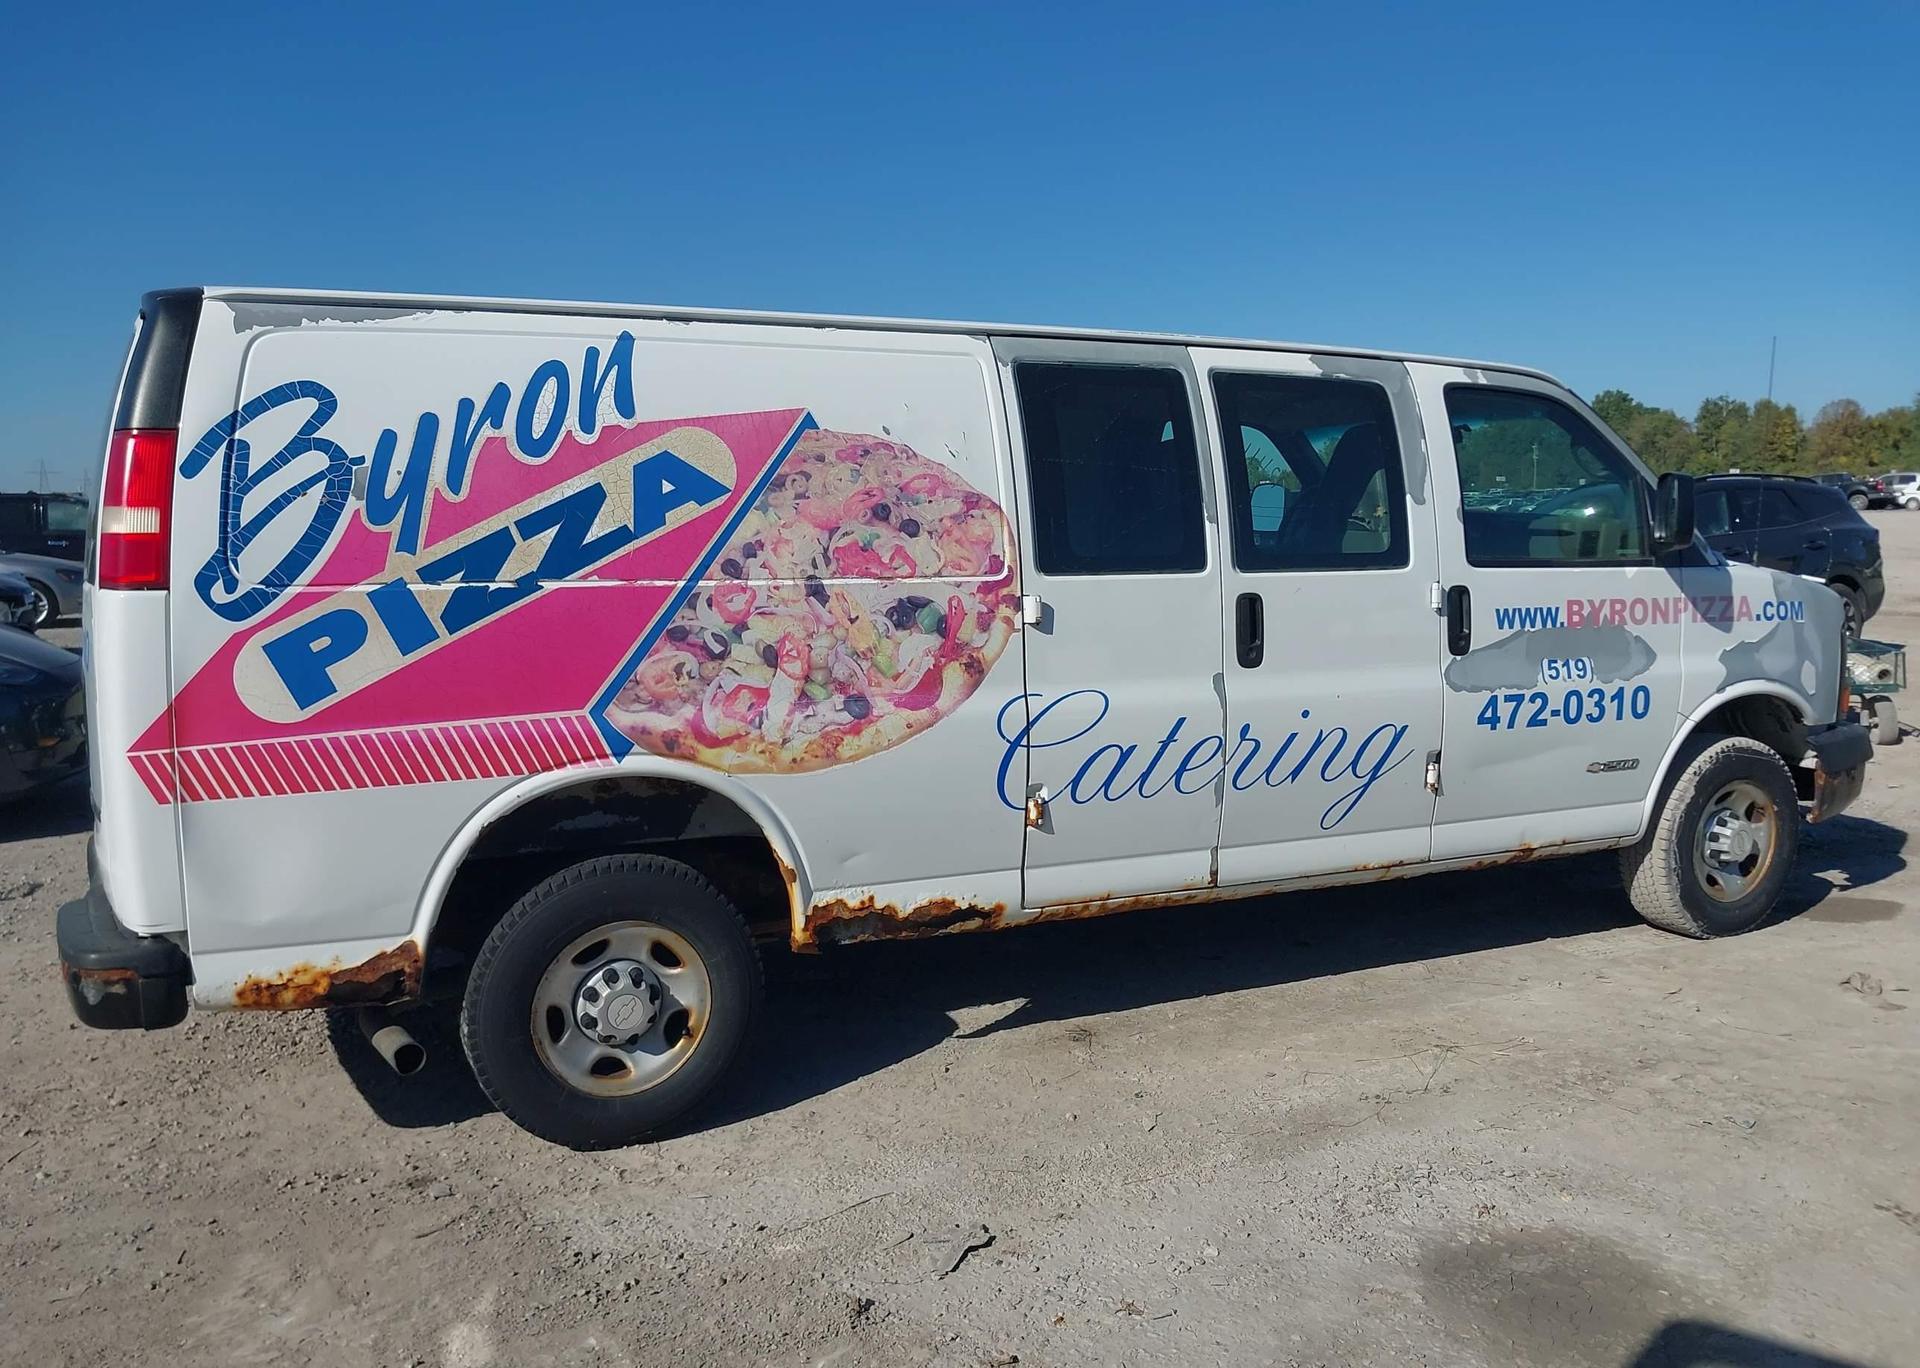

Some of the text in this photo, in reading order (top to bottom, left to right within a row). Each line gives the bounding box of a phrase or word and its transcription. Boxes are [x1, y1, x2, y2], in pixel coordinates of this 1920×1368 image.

[178, 330, 636, 622] Byron
[261, 450, 732, 710] PIZZA
[1476, 685, 1650, 731] 472-0310
[1540, 656, 1594, 684] (519)
[996, 689, 1415, 830] Catering
